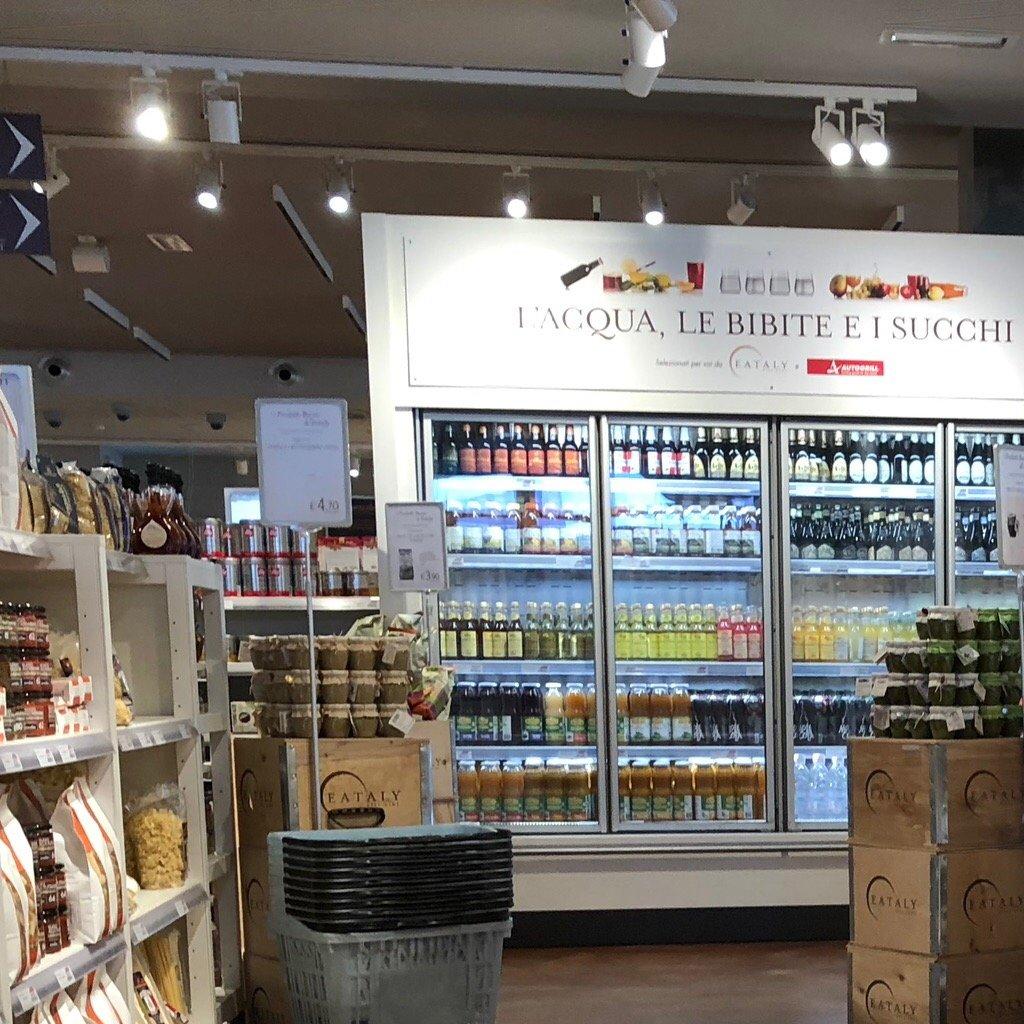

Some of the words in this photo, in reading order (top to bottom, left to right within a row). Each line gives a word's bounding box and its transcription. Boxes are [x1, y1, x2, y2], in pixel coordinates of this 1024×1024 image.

[518, 306, 664, 340] L'ACQUA,
[678, 310, 716, 335] LE
[728, 311, 833, 338] BIBITE
[845, 315, 861, 339] E
[874, 316, 881, 339] I
[892, 317, 1014, 343] SUCCHI
[328, 790, 401, 803] EATALY
[870, 894, 918, 910] EATALY
[870, 997, 917, 1016] EATALY
